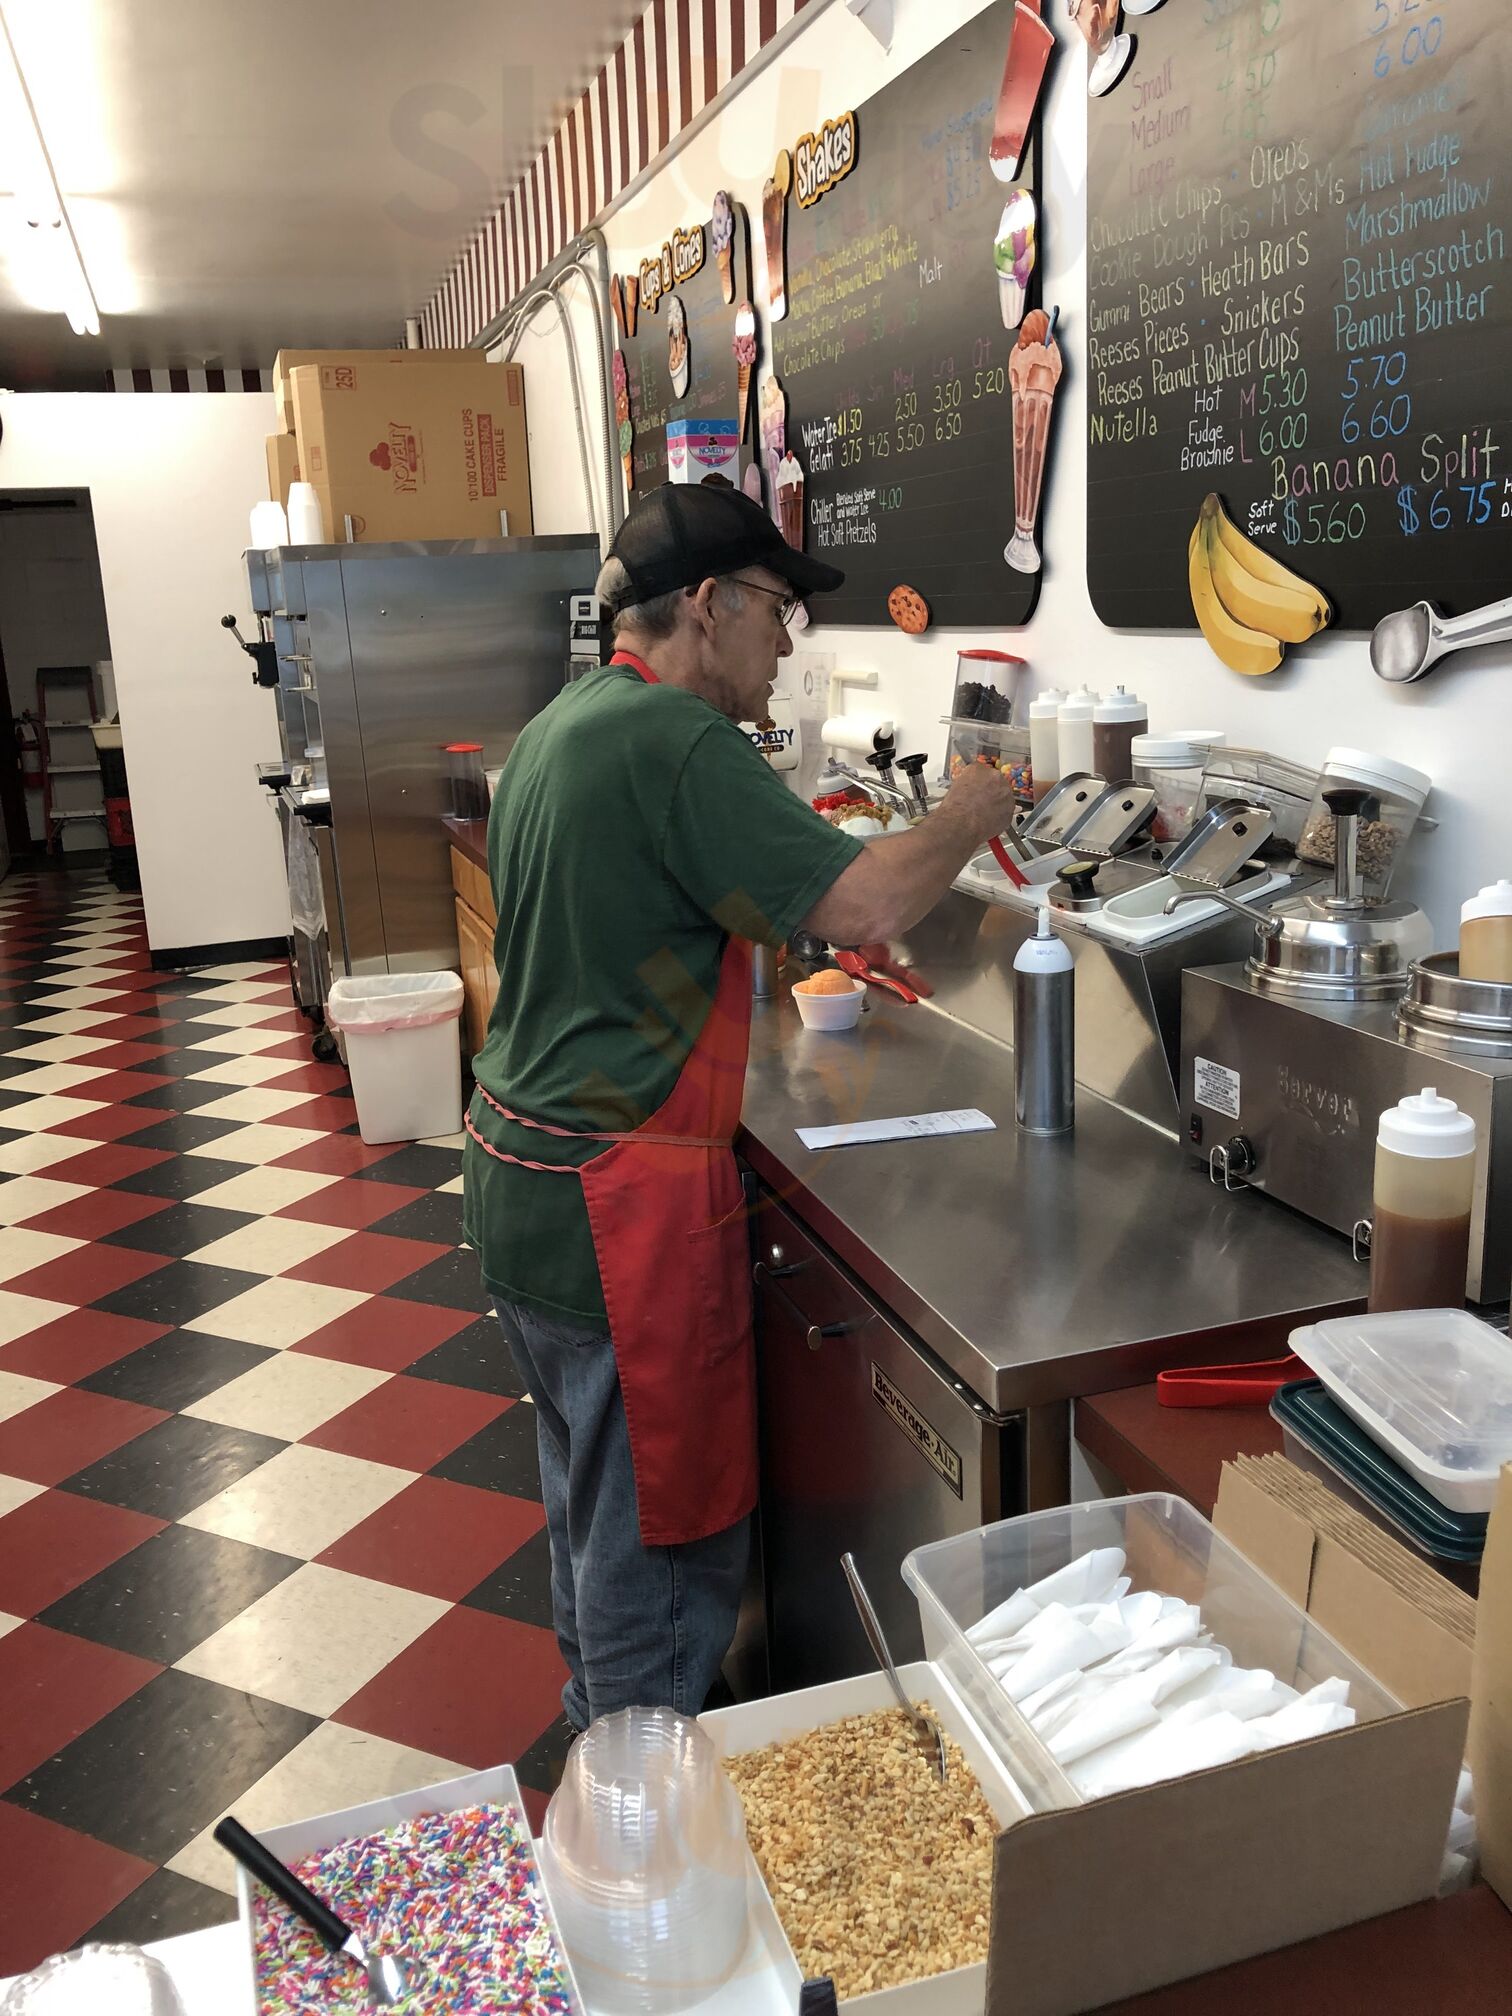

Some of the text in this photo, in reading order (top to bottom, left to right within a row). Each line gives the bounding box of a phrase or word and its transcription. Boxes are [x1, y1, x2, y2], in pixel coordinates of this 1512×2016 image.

[1132, 58, 1172, 111] Small
[1132, 105, 1191, 150] Medium
[797, 122, 850, 200] Shakes
[1130, 156, 1175, 197] Large
[1359, 133, 1462, 195] Hot Fudge
[1176, 179, 1222, 224] Chips
[1346, 177, 1494, 251] Marshmallow
[640, 234, 701, 305] Cups & Cones
[919, 254, 943, 288] Malt
[1089, 249, 1142, 291] Cookie
[1154, 219, 1209, 268] Dough
[1089, 231, 1310, 332] Gummi Bears Heath Bars
[1343, 223, 1504, 301] Butterscotch
[1089, 284, 1305, 370] Reeses Pieces Snickers
[1334, 280, 1494, 351] Peanut Butter
[784, 338, 845, 376] Chocolate Chips
[1098, 327, 1299, 406] Reeses Peanut Butter Cups
[1194, 352, 1406, 419] Hot M 5.30 5.70
[462, 408, 473, 437] CUPS
[802, 421, 825, 448] Water
[823, 416, 838, 444] Ice
[933, 379, 962, 413] 3.50
[1091, 407, 1158, 445] Nutella
[1188, 394, 1411, 463] Fudge L 6.00 6.60
[389, 421, 417, 494] NOVELTY
[464, 440, 476, 469] CAKE
[479, 417, 494, 493] DISPENSER PACK
[495, 428, 507, 482] FRAGILE
[809, 444, 834, 473] Gelati
[841, 437, 862, 467] 3.75
[1181, 445, 1234, 471] Brownie
[1271, 428, 1500, 500] Banana Split
[811, 498, 834, 525] Chiller
[854, 490, 863, 504] Soft
[863, 488, 876, 502] Serve
[879, 487, 903, 511] 4.00
[818, 517, 877, 547] Hot Soft Pretzels
[836, 502, 869, 519] and Water Ice
[1248, 500, 1274, 519] Soft
[1248, 521, 1278, 536] Serve
[749, 728, 794, 746] OVELTY
[1205, 1081, 1229, 1095] ATTENTION
[1207, 1063, 1227, 1076] CAUTION
[1278, 1064, 1352, 1121] Server
